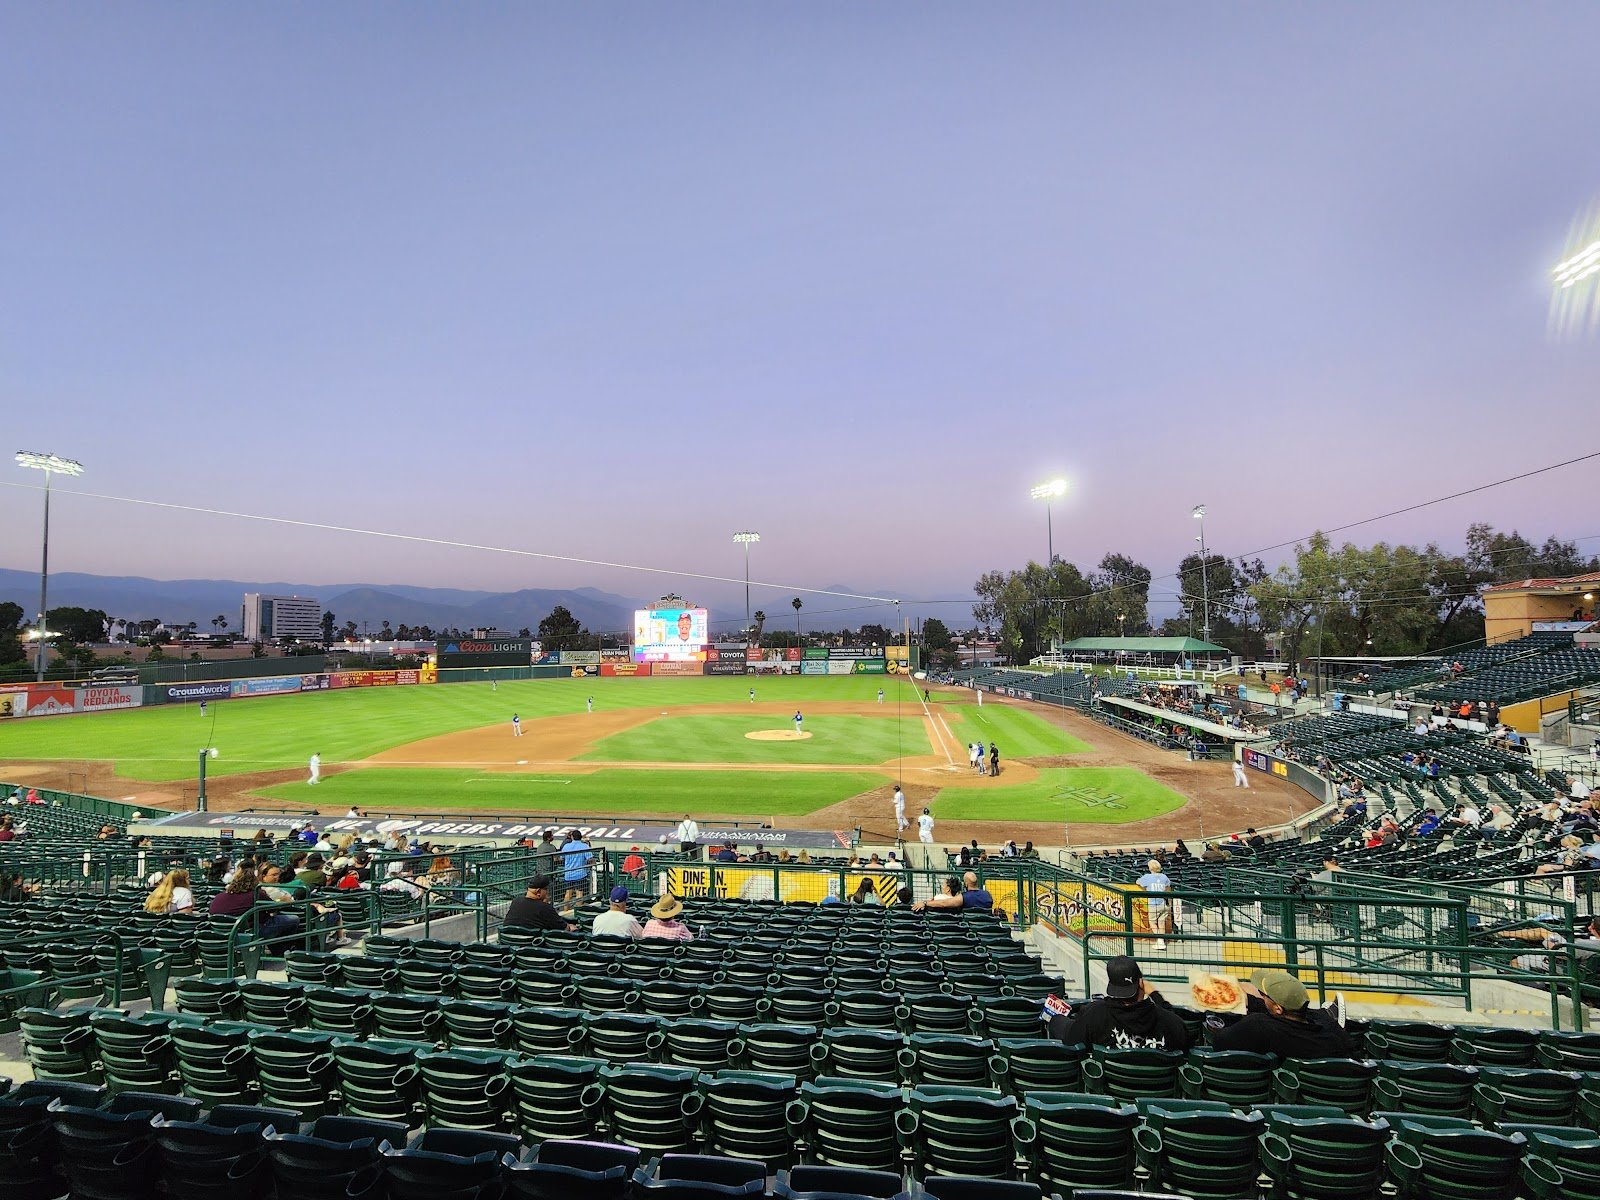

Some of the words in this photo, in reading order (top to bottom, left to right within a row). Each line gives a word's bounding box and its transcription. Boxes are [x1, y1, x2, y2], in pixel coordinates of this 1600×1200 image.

[459, 640, 492, 652] Coors
[493, 643, 522, 652] LIGHT
[84, 688, 120, 698] TOYOTA
[168, 684, 231, 697] Groundworks
[83, 695, 132, 706] REDLANDS
[502, 824, 636, 838] BASEBALL
[682, 870, 706, 885] DINE
[682, 885, 728, 899] TAKEUT
[1037, 890, 1122, 925] Sophia's
